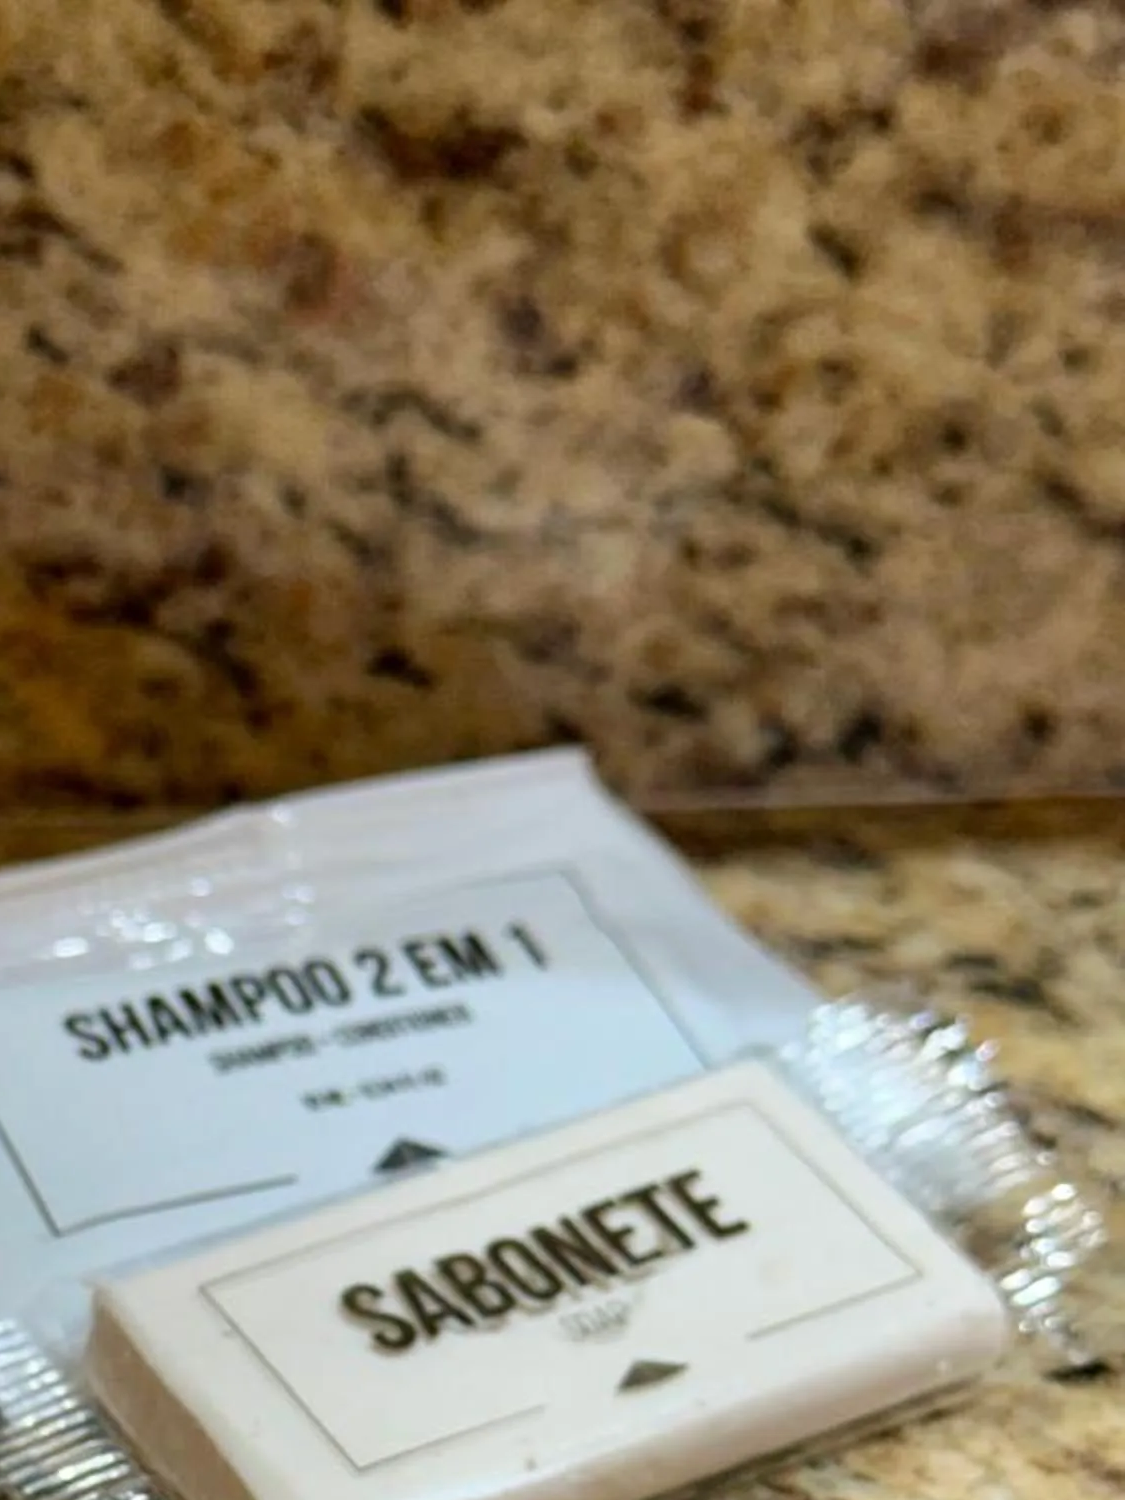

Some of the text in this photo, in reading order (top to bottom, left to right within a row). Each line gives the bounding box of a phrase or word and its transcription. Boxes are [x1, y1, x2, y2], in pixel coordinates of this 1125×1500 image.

[62, 921, 549, 1062] SHAMPOO 2 EM 1
[338, 1168, 750, 1356] SABONETE
